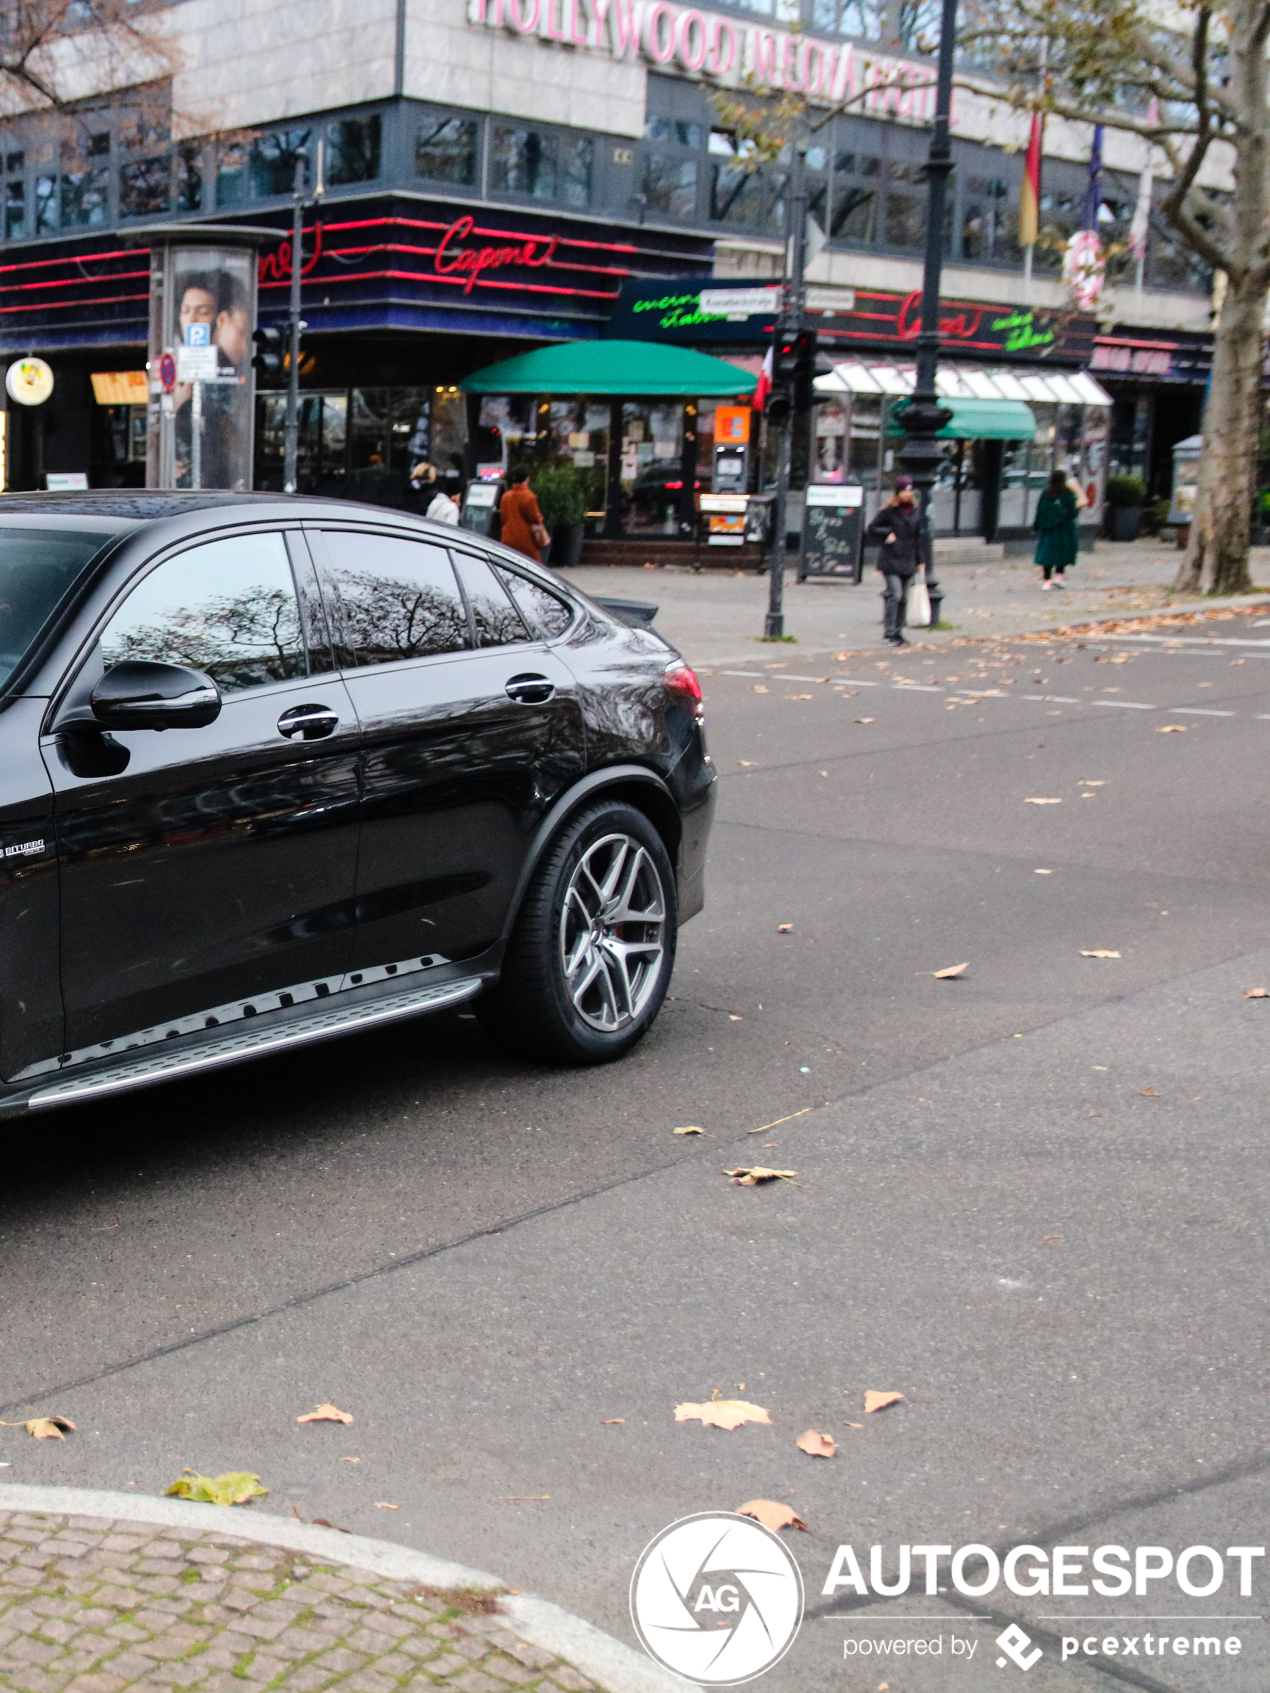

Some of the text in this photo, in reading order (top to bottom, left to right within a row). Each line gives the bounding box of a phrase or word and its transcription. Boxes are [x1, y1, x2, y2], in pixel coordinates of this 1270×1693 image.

[745, 29, 857, 98] MEDIA
[865, 59, 961, 126] HOTL
[435, 215, 560, 295] Capone
[5, 839, 44, 855] BITURBO
